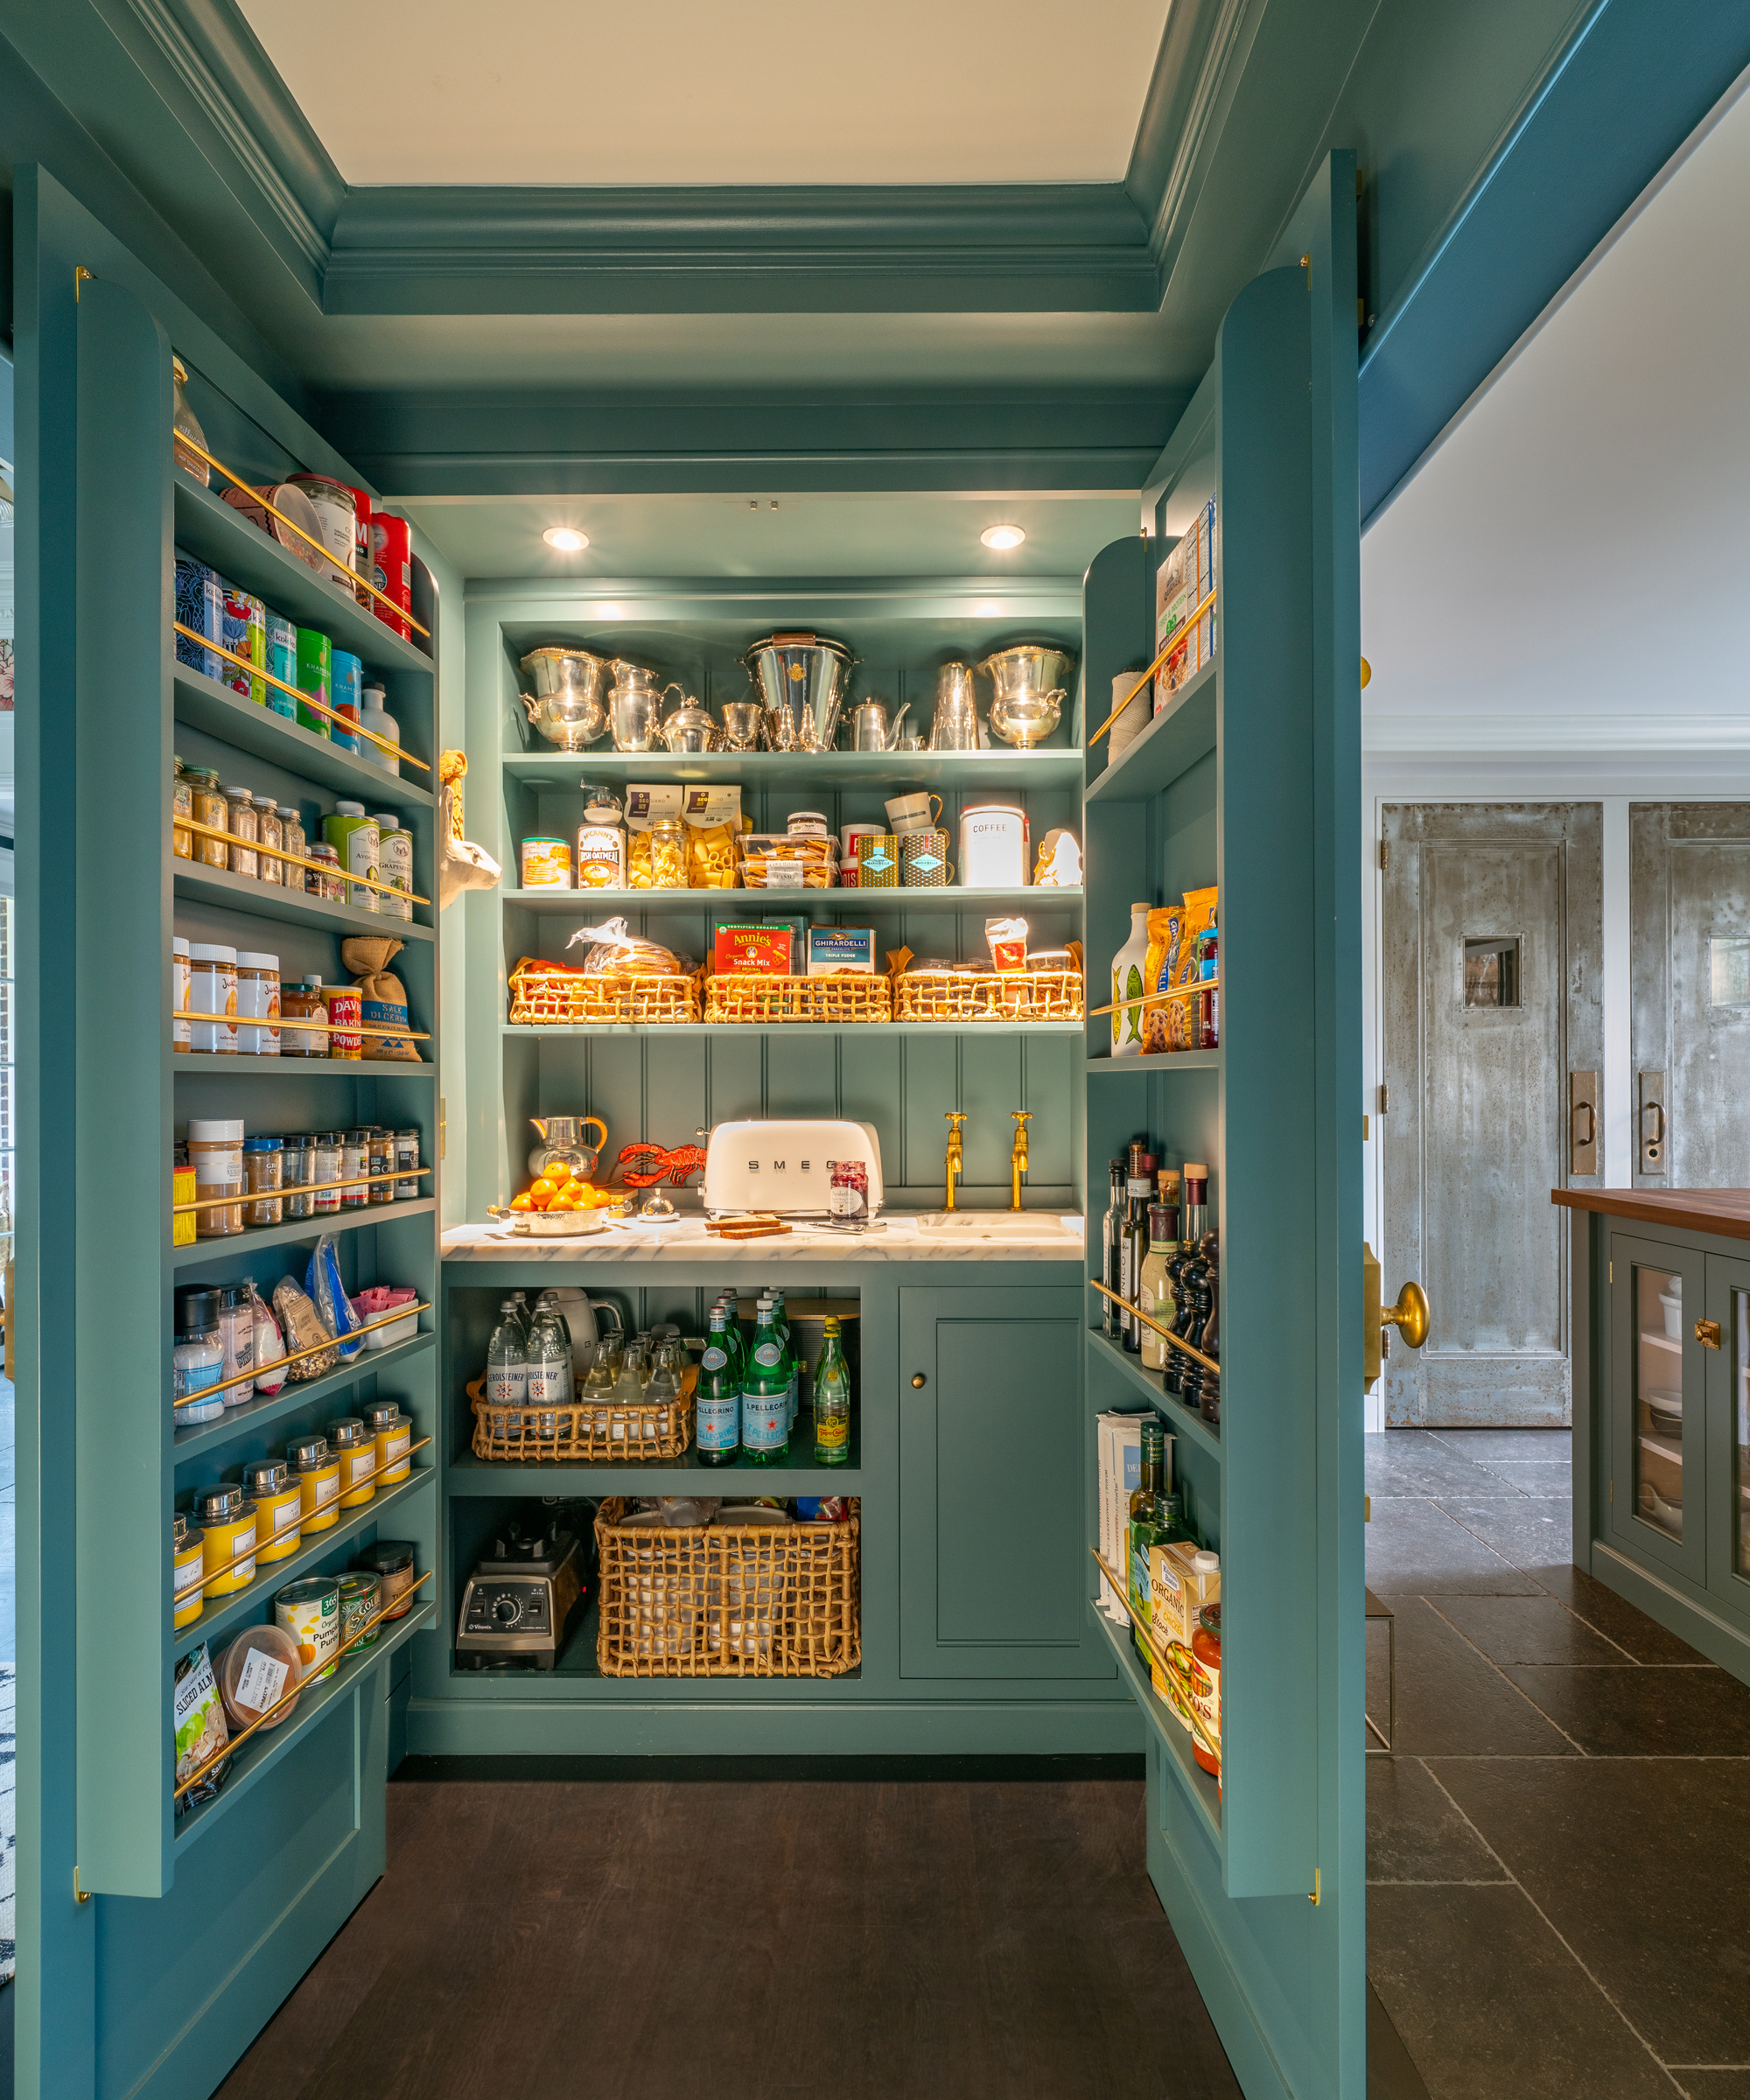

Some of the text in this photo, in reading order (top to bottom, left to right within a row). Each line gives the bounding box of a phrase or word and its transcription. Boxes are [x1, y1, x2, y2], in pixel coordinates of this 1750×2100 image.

[1171, 592, 1186, 612] PROTEIN
[973, 824, 1006, 833] COFFEE
[592, 851, 620, 863] OATMEAL
[734, 932, 772, 947] Annie's
[382, 1004, 402, 1014] SALE
[487, 1372, 526, 1382] GEROLSTEINER
[323, 1594, 337, 1611] 365
[1151, 1578, 1185, 1619] ORGANIC
[1152, 1613, 1169, 1636] Stock
[1163, 1612, 1184, 1638] CHICKEN
[176, 1687, 199, 1716] SLICED
